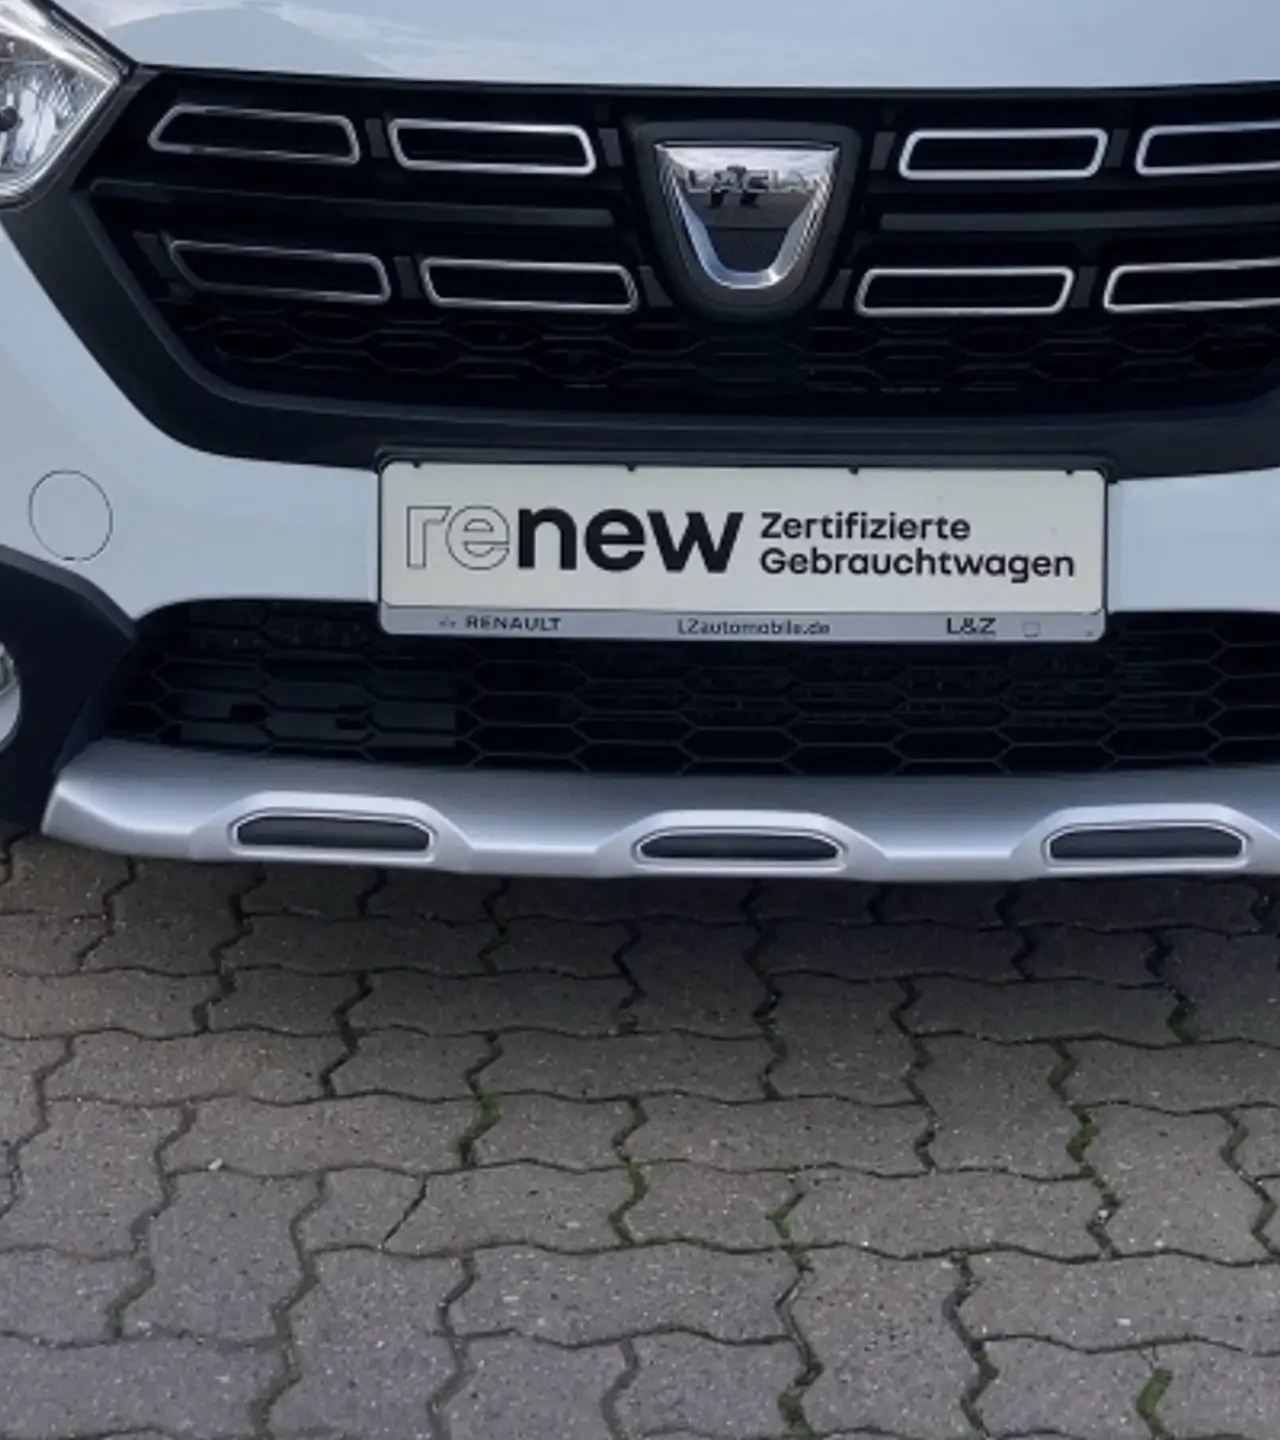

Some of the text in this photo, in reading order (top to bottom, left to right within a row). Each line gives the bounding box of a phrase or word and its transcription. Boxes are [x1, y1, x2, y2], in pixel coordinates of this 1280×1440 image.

[407, 505, 744, 573] renew
[760, 511, 971, 540] Zertifizierte
[759, 546, 1075, 583] Gebrauchtwagen
[465, 615, 562, 632] RENAULT
[946, 617, 997, 636] L&Z
